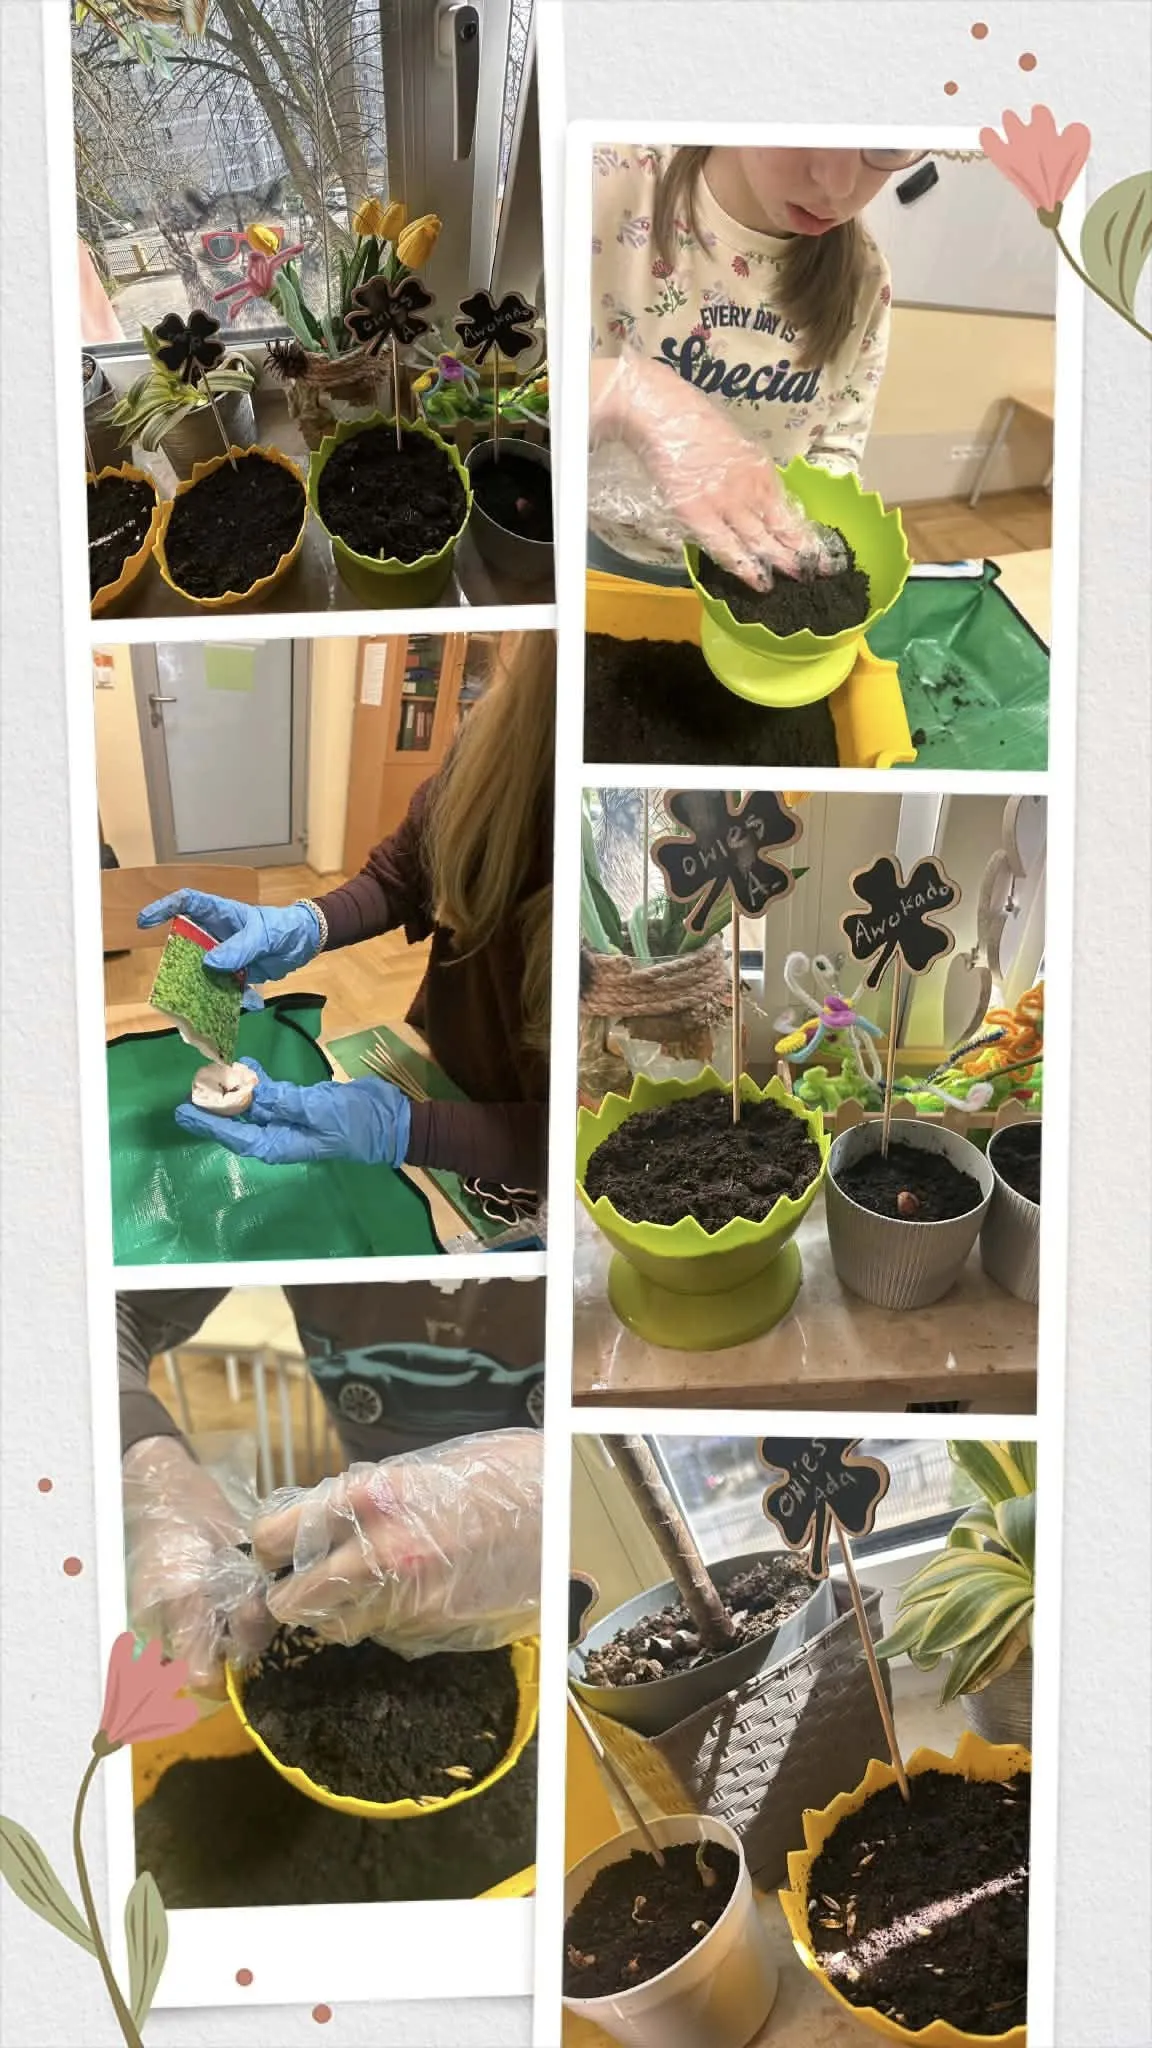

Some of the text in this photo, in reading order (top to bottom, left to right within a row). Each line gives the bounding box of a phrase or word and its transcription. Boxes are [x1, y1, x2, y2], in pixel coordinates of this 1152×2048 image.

[700, 305, 799, 343] EVERY DAY IS
[652, 335, 824, 403] Special
[854, 880, 949, 947] Awokado
